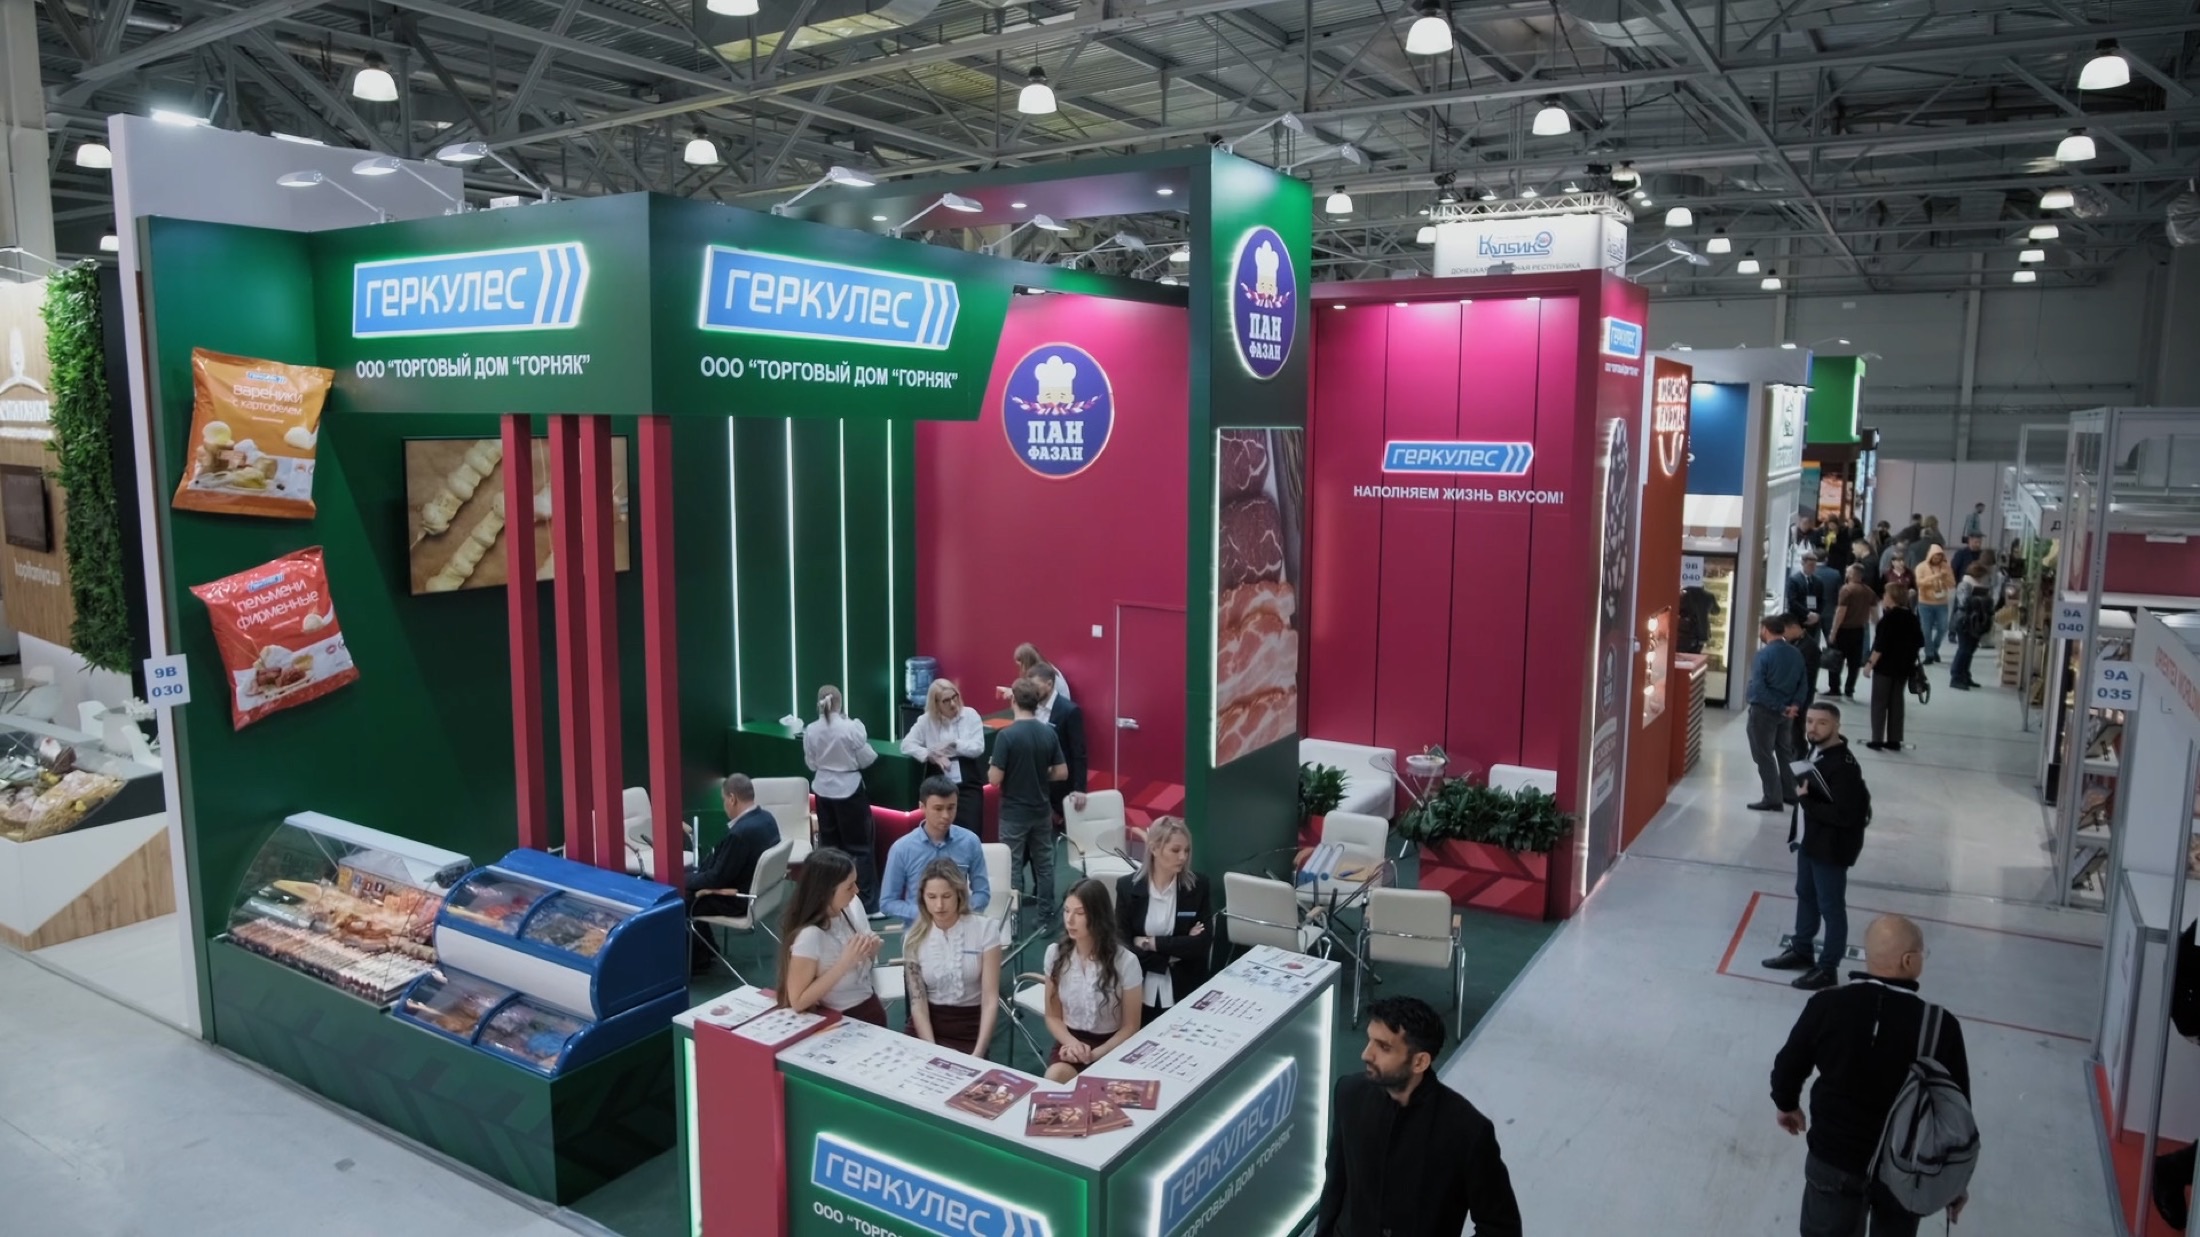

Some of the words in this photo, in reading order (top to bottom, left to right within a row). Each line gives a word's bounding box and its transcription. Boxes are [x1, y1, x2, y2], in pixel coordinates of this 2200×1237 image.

[1532, 262, 1581, 272] РЕСПУБЛИКА
[1249, 312, 1282, 342] ПАН
[1249, 341, 1281, 361] ФАЗАН
[356, 360, 385, 378] ООО
[474, 356, 509, 379] ДОМ
[700, 356, 744, 378] ООО
[854, 366, 888, 387] ДОМ
[233, 384, 304, 404] вареники
[241, 400, 303, 416] картофелем
[1027, 420, 1084, 444] ПАН
[1027, 445, 1083, 461] ФАЗАН
[1353, 485, 1439, 500] НАПОЛНЯЕМ
[1443, 488, 1494, 502] ЖИЗНЬ
[1498, 489, 1564, 504] ВКУСОМ!
[236, 579, 307, 613] пельмени
[237, 590, 319, 631] фирменные
[2063, 609, 2082, 619] 9A
[2057, 623, 2084, 633] 040
[154, 666, 177, 679] 9B
[2104, 669, 2129, 682] 9A
[151, 683, 183, 698] 030
[2097, 687, 2132, 701] 035
[1234, 1163, 1256, 1197] ДОМ
[813, 1201, 844, 1224] ООО
